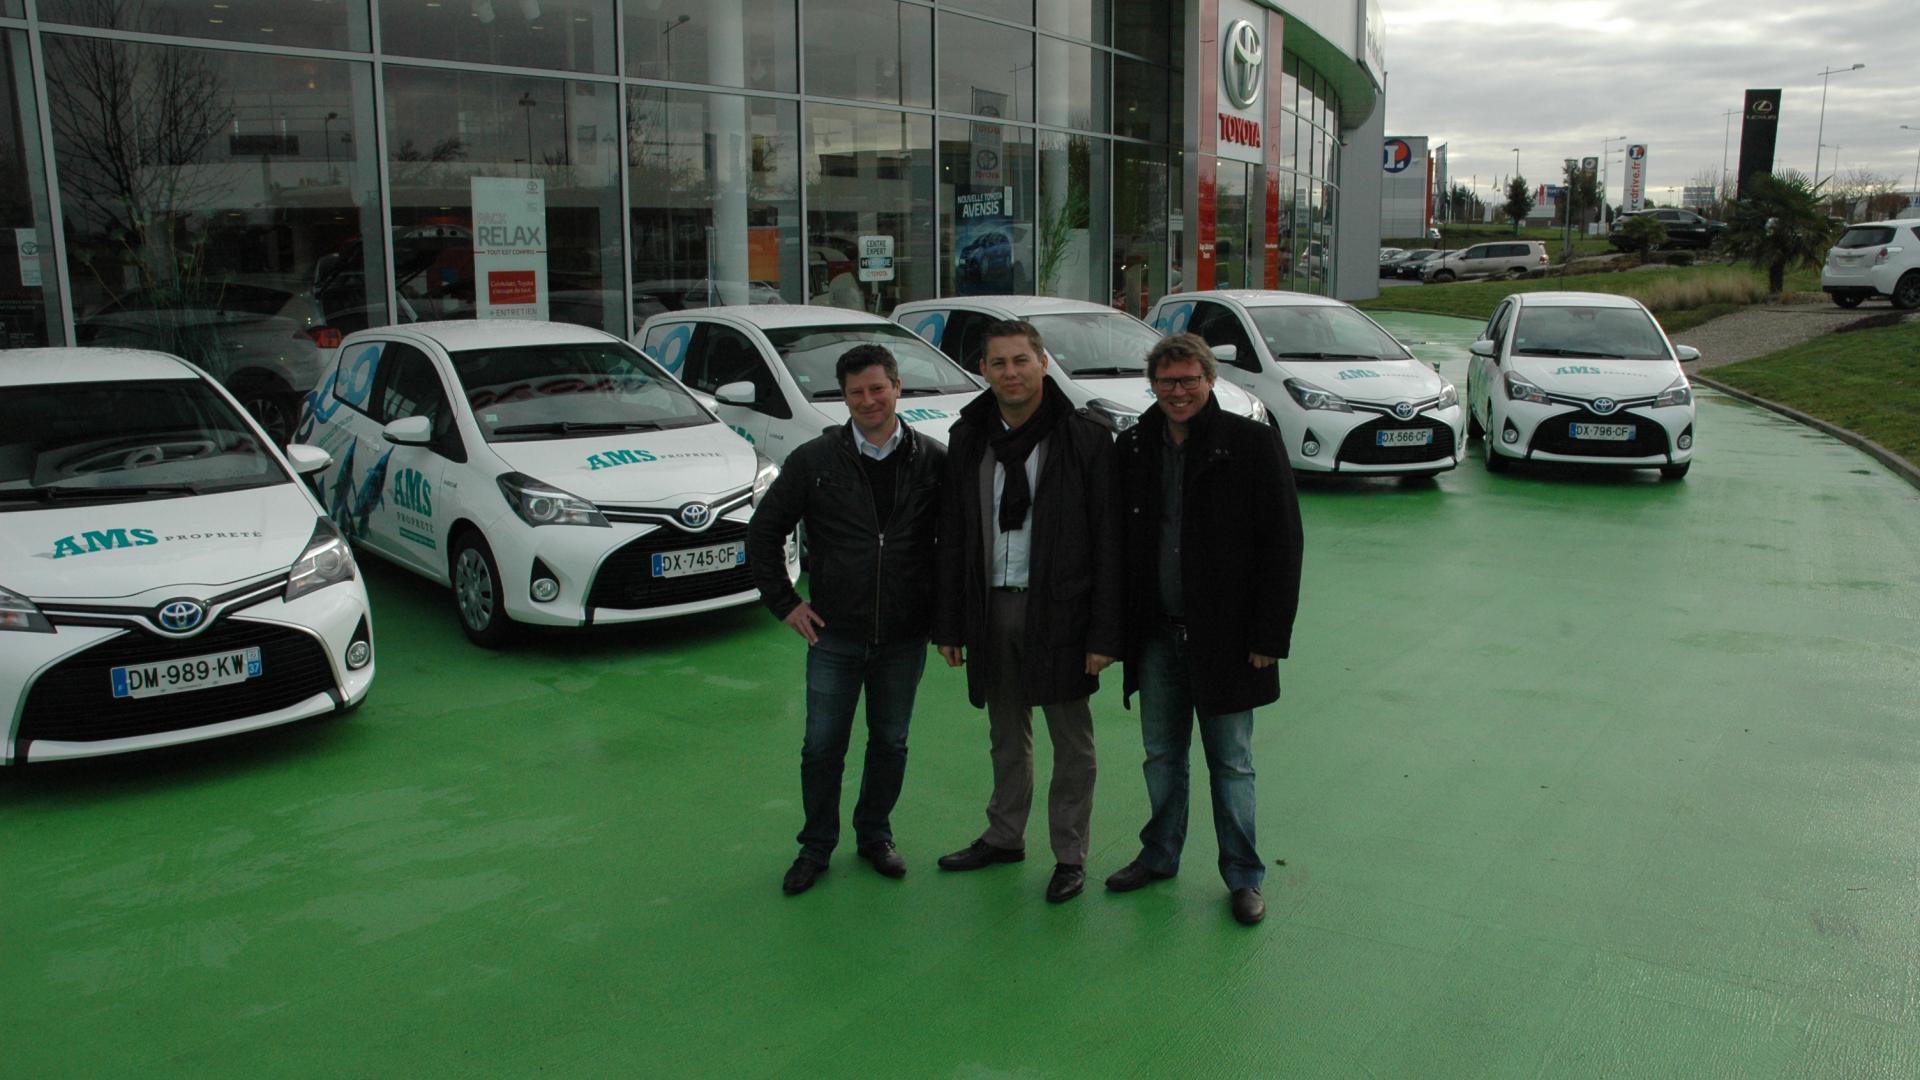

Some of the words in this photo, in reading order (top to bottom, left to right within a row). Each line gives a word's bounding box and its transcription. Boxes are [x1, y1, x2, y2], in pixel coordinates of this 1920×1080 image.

[1219, 113, 1261, 148] TOYOTA
[1630, 162, 1641, 210] rcdrive.fr
[958, 194, 983, 204] NOUVELLE
[962, 201, 999, 218] AVENSIS
[478, 226, 541, 247] RELAX
[866, 240, 887, 248] CENTRE
[866, 248, 886, 256] EXPERT
[1339, 369, 1380, 380] AMS
[1556, 366, 1600, 375] AMS
[1382, 431, 1427, 442] DX-566-CF
[1576, 426, 1628, 437] DX-796-CF
[587, 450, 657, 470] AMS
[394, 468, 432, 517] AMS
[53, 528, 159, 559] AMS
[165, 530, 263, 542] PROPRETÉ
[662, 546, 735, 571] DX-745-CF
[128, 654, 243, 691] DM-989-KW
[250, 662, 260, 674] 37
